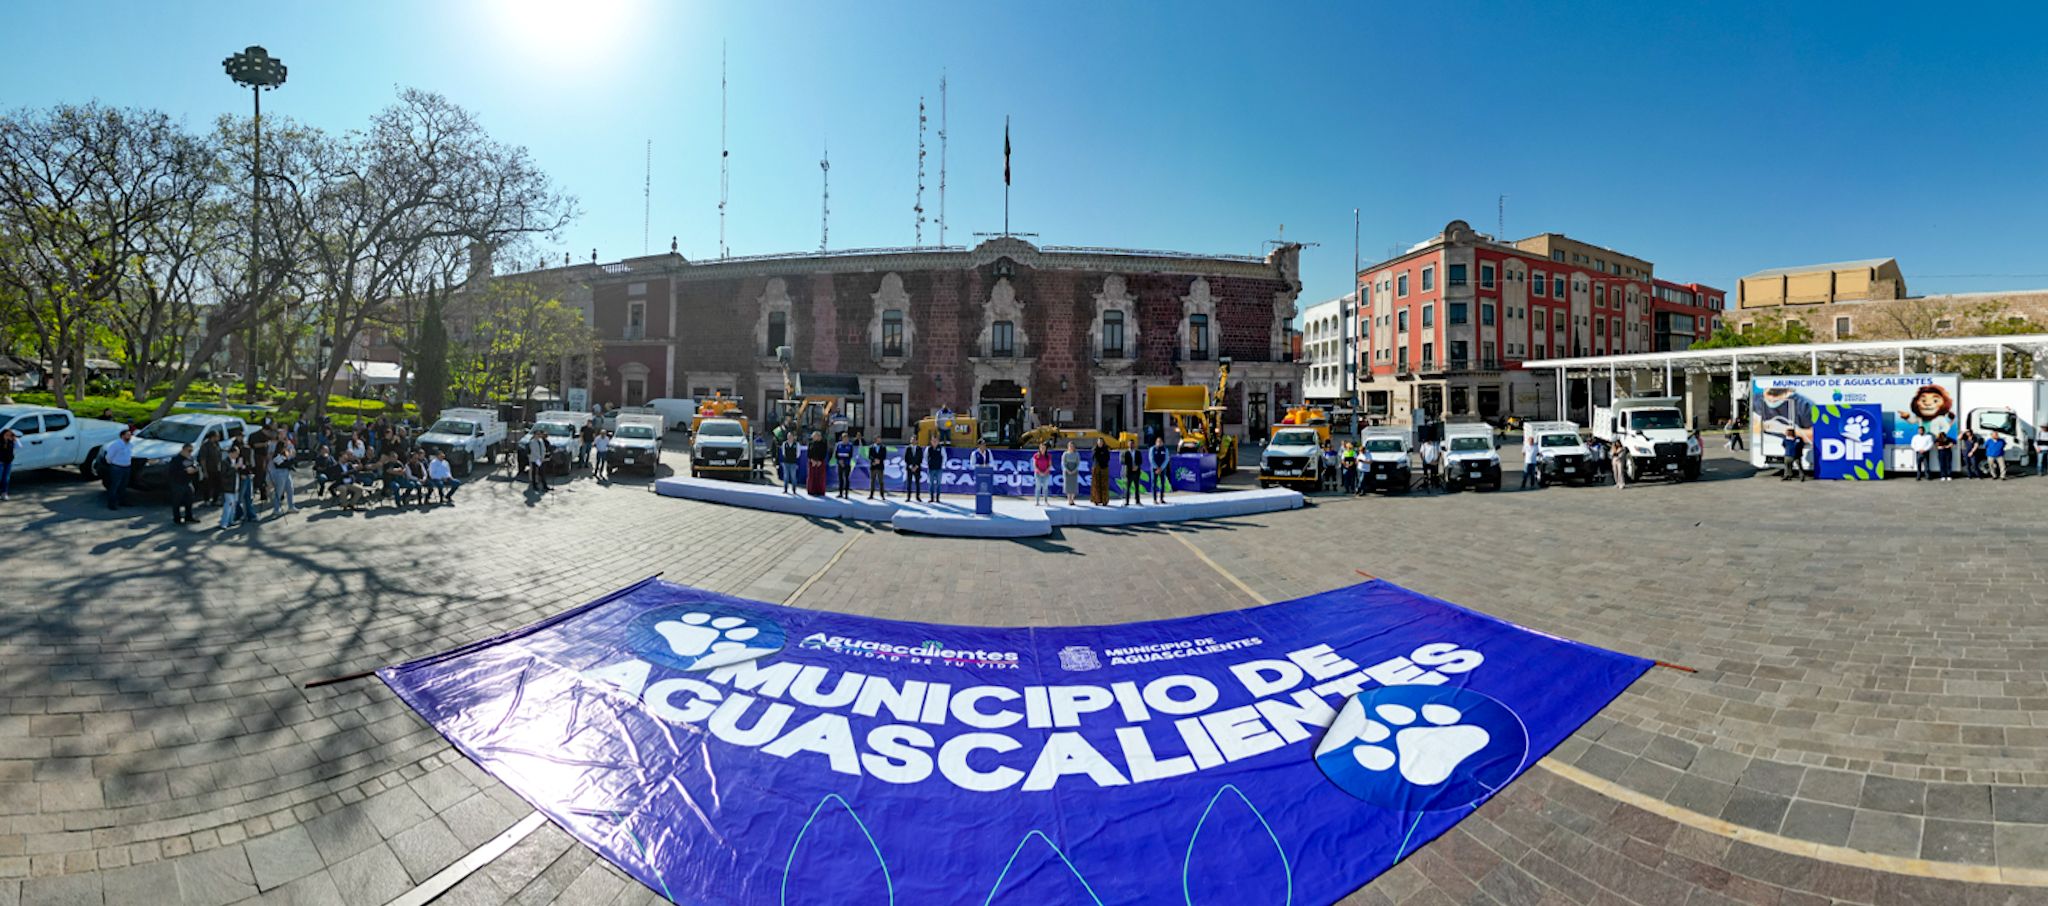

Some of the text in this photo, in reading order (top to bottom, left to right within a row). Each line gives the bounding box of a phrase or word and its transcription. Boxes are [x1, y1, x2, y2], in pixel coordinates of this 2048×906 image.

[1773, 379, 1825, 387] MUNICIPIO
[1844, 377, 1933, 386] AGUASCALIENTES
[955, 424, 968, 433] CAT
[1821, 438, 1874, 461] DIF
[799, 632, 1019, 662] Aguascalientes
[834, 646, 900, 662] CIUDAD
[911, 657, 933, 665] DE
[977, 661, 1020, 669] VIDA
[1105, 636, 1217, 657] MUNICIPIO DE
[1110, 636, 1264, 666] AGUASCALIENTES
[706, 642, 1360, 730] MUNICIPIO DE
[581, 642, 1485, 793] AGUASCALIENTES
